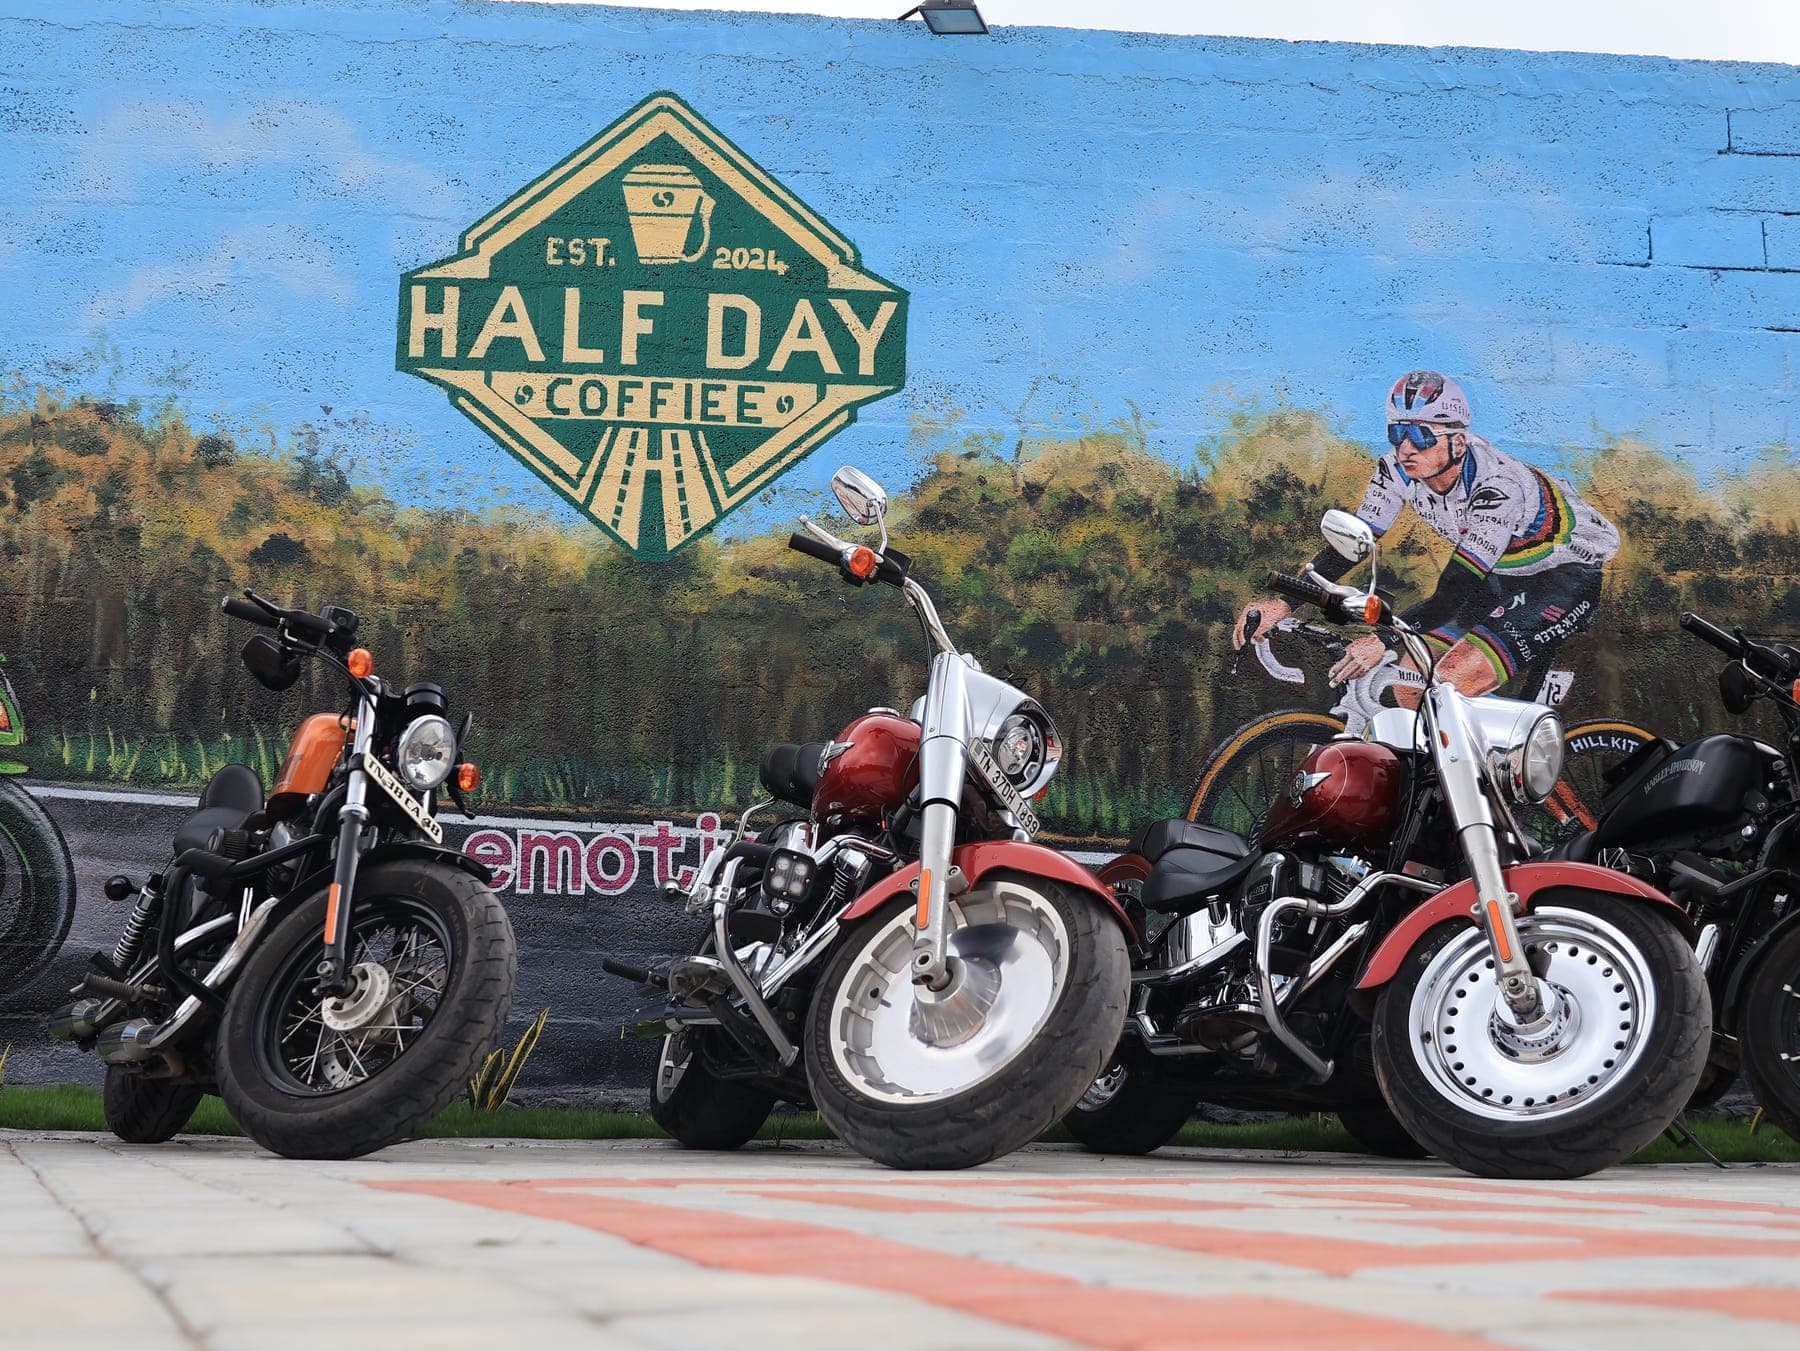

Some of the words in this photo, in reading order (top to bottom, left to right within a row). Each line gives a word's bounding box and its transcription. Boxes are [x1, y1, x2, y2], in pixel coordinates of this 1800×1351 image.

[546, 236, 616, 266] EST.
[712, 246, 789, 276] 2024
[408, 285, 665, 366] HALF
[705, 293, 898, 376] DAY
[546, 377, 766, 424] COFFIEE
[1570, 735, 1608, 753] HILL
[1611, 736, 1639, 753] KIT
[367, 758, 385, 779] TN
[979, 751, 993, 773] TN
[991, 770, 1017, 805] 37DH
[1015, 802, 1039, 834] 1899
[461, 812, 733, 895] emoti
